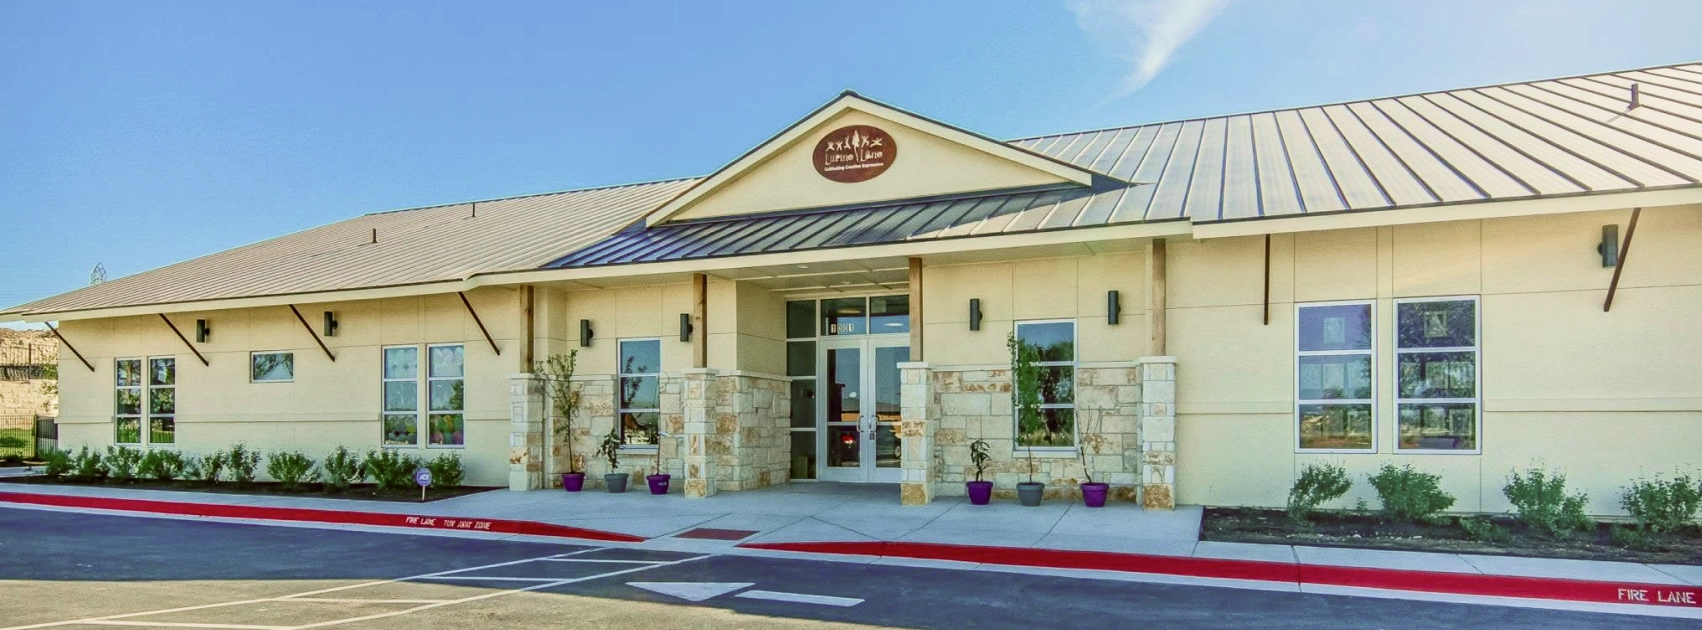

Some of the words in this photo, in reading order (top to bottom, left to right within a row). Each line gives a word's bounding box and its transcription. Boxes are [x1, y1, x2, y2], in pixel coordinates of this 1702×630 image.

[860, 149, 883, 162] Lane
[405, 516, 419, 525] FIRE
[420, 517, 436, 526] LANE
[474, 521, 492, 530] ZONE
[1618, 588, 1649, 602] FIRE
[1657, 590, 1696, 604] LANE
